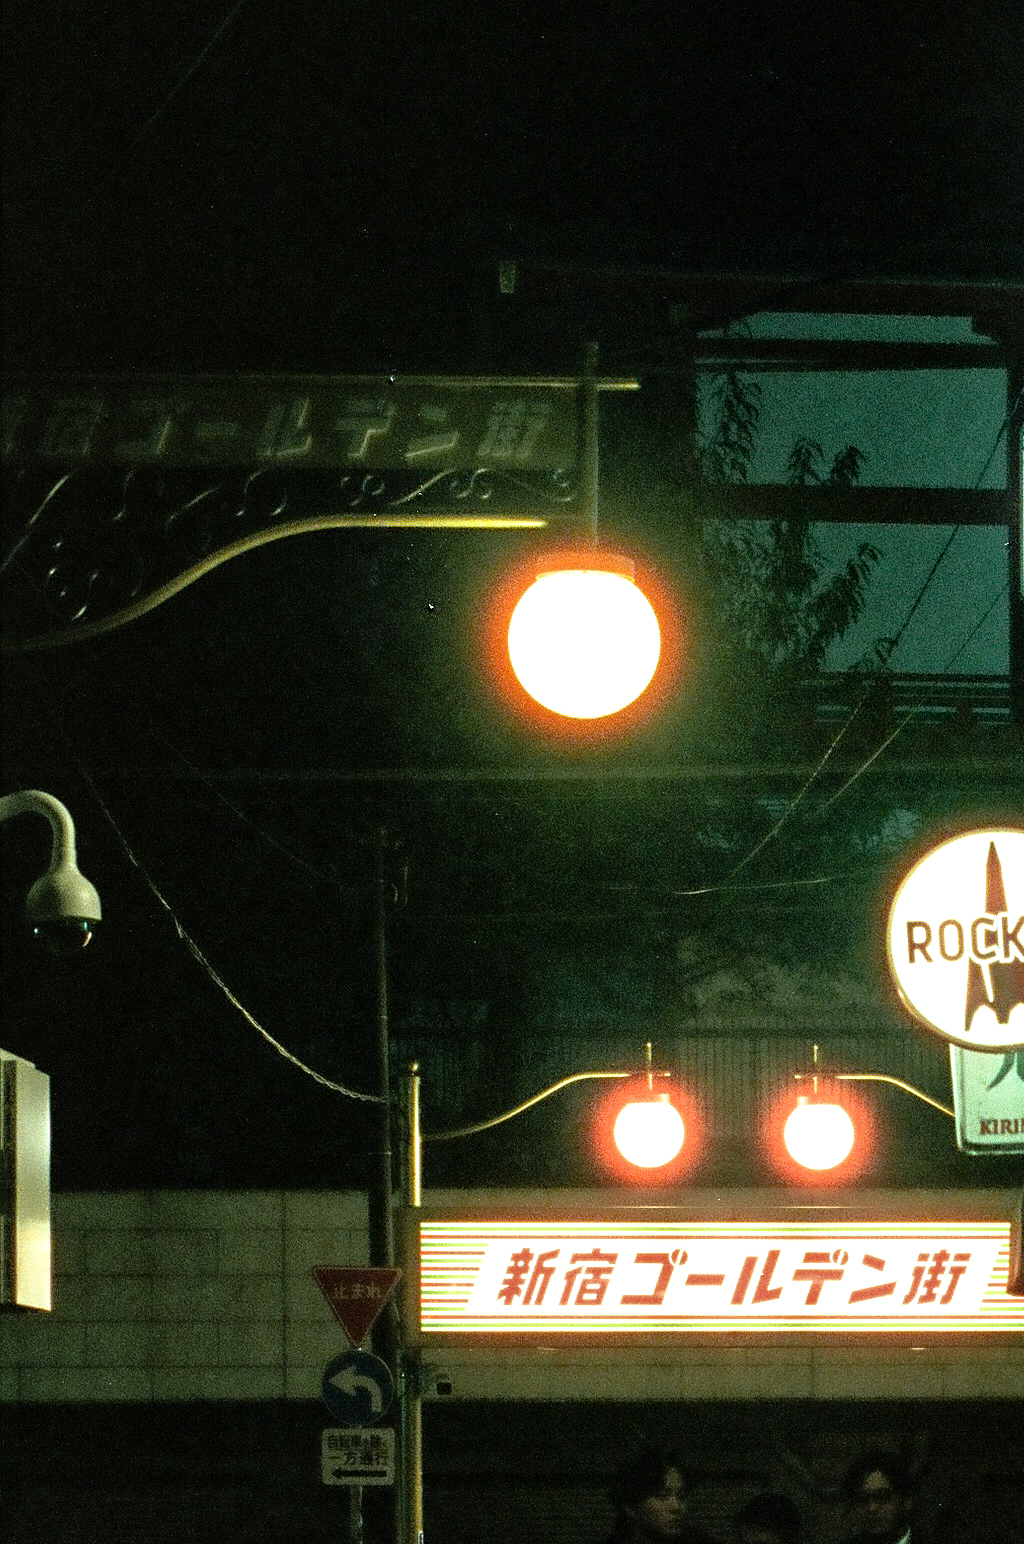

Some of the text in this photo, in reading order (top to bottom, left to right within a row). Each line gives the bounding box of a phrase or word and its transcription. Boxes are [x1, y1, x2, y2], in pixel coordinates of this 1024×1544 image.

[496, 1247, 972, 1306] 新宿ゴールデン街
[332, 1281, 382, 1300] 止まれ
[328, 1451, 388, 1466] 一方通行
